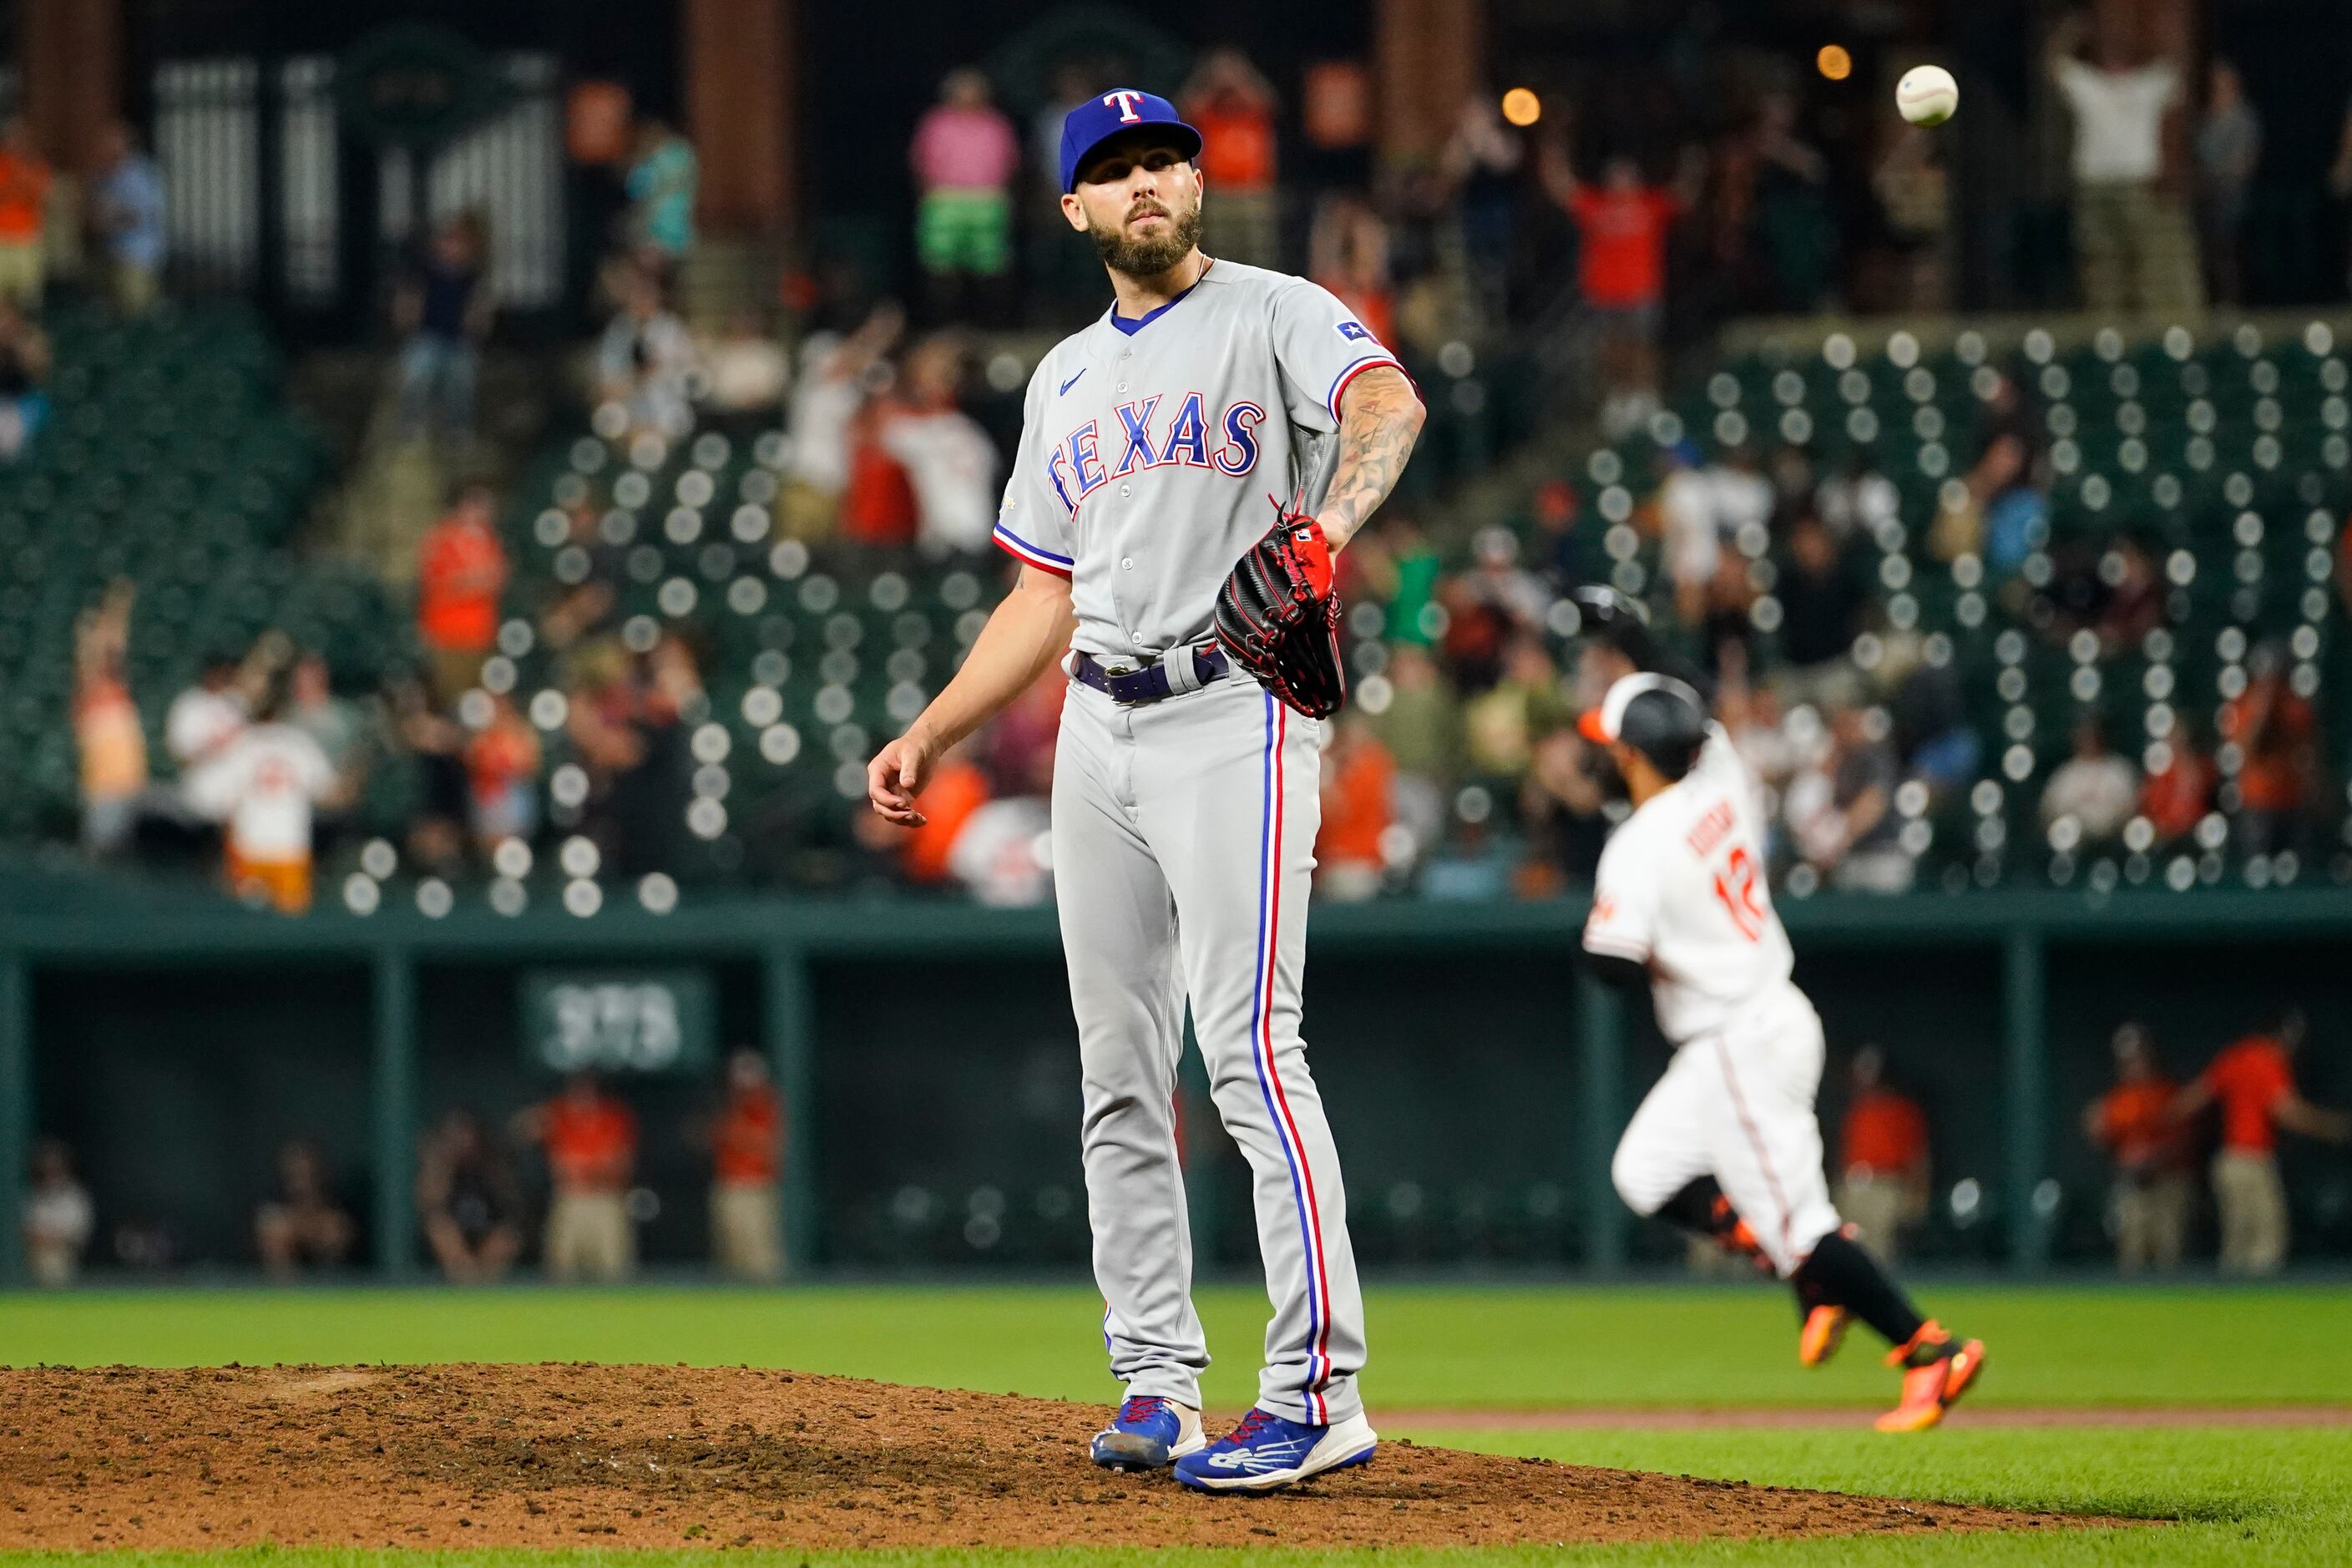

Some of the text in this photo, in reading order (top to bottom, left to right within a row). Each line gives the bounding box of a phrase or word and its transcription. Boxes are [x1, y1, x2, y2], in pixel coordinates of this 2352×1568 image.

[1103, 90, 1144, 124] T
[1047, 392, 1267, 523] TEXAS
[1713, 847, 1765, 943] 12
